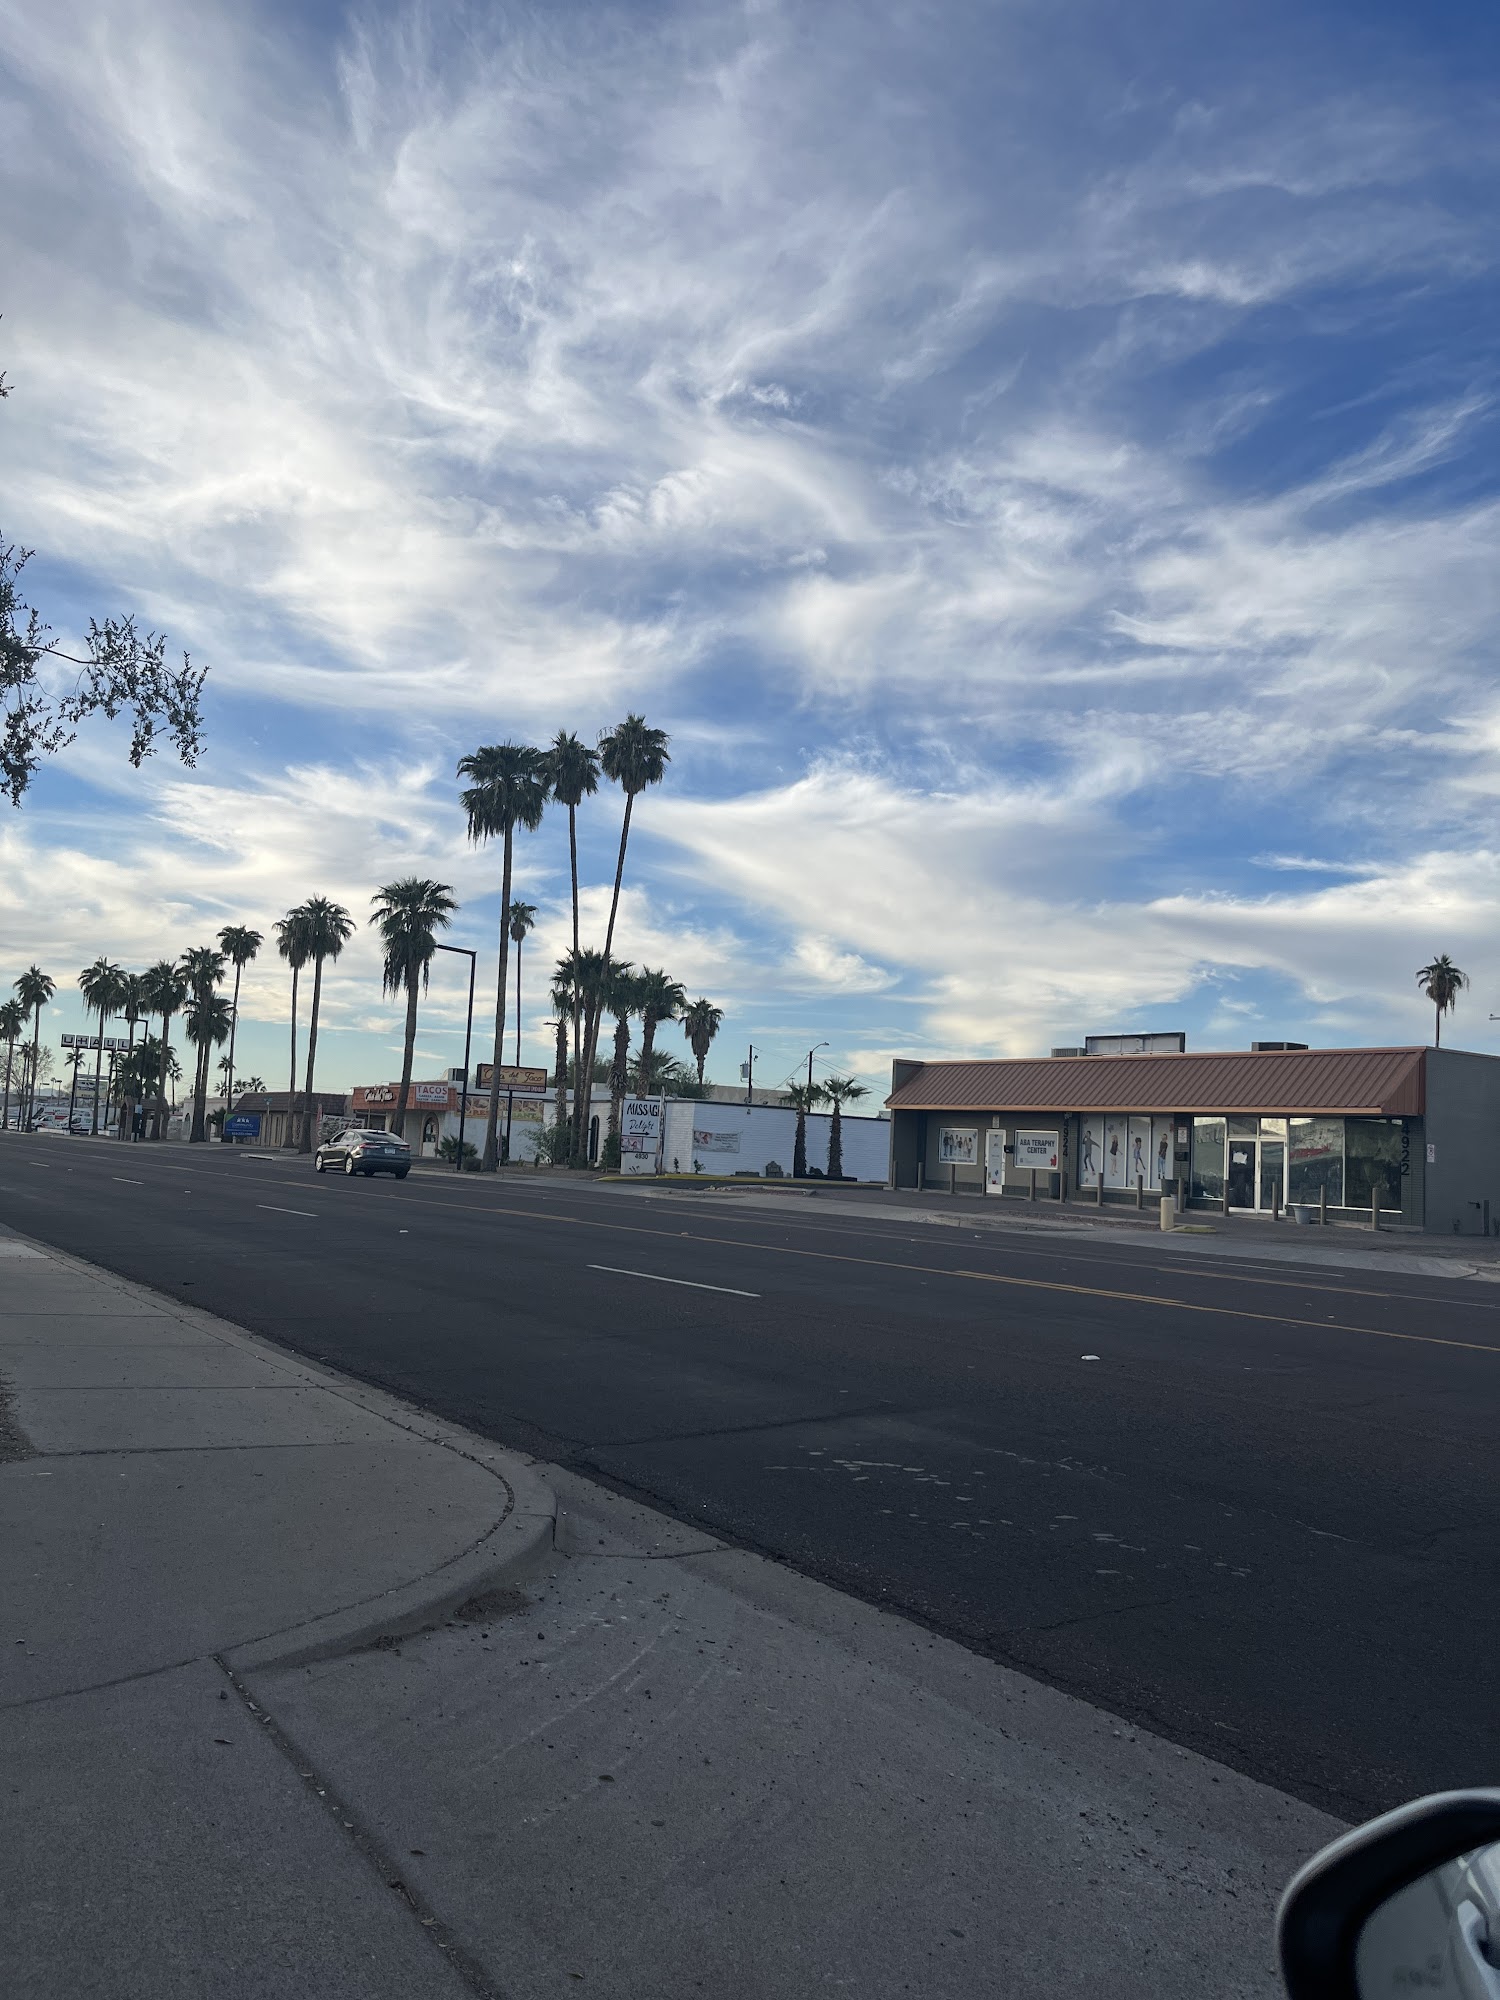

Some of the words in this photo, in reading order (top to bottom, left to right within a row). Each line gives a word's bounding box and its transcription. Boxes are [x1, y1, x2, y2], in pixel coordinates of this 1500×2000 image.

[524, 1071, 544, 1082] Taco
[417, 1086, 448, 1095] TACOS
[629, 1119, 654, 1132] Delight
[1401, 1123, 1410, 1175] 4922
